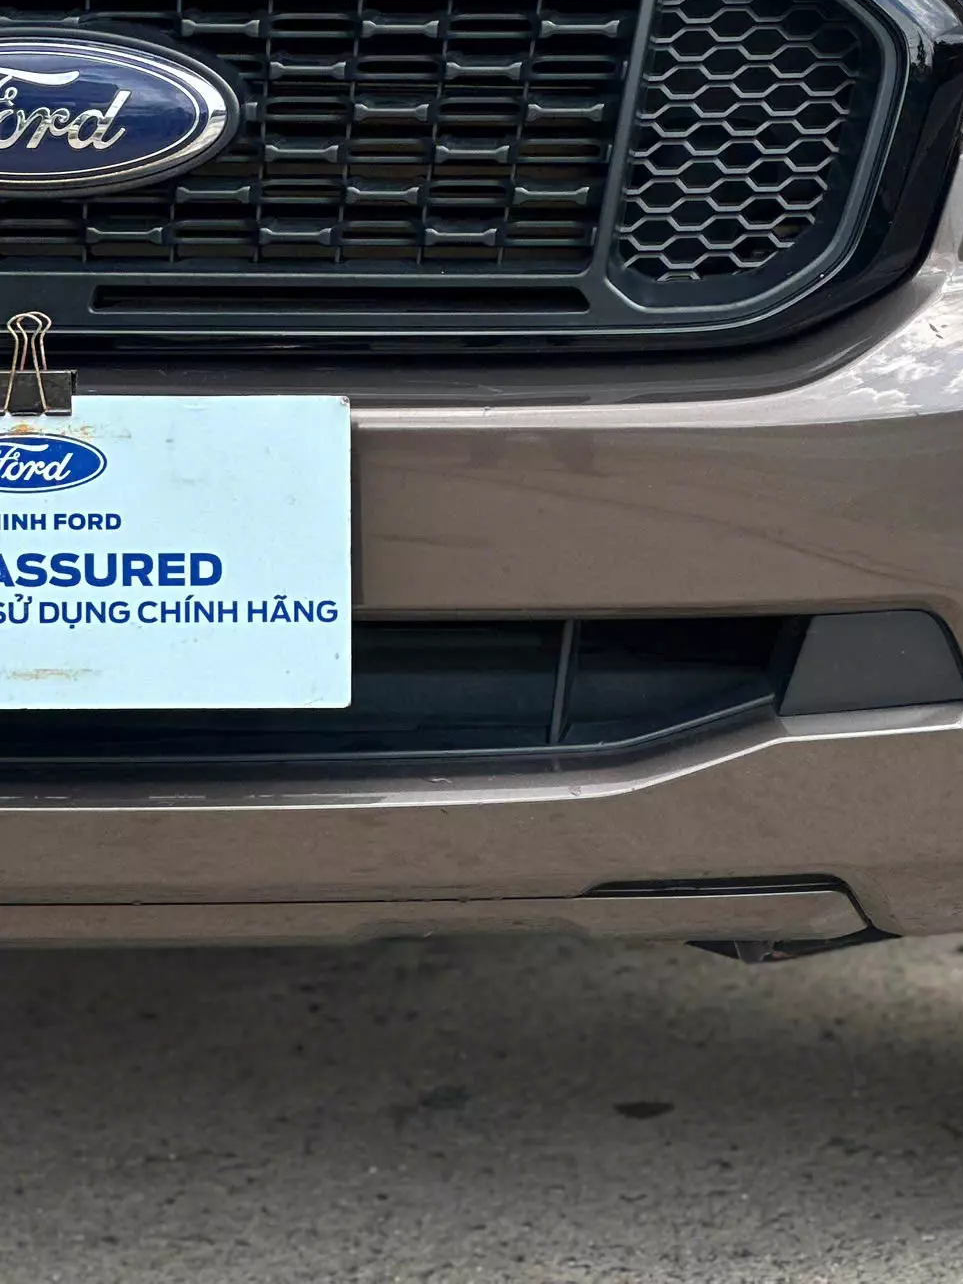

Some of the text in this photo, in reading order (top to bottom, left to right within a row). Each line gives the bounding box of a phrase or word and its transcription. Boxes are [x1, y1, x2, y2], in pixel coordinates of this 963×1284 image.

[0, 512, 122, 531] INH FORD
[39, 601, 131, 630] DỤNG
[137, 594, 238, 624] CHÍNH
[247, 594, 338, 624] HÃNG
